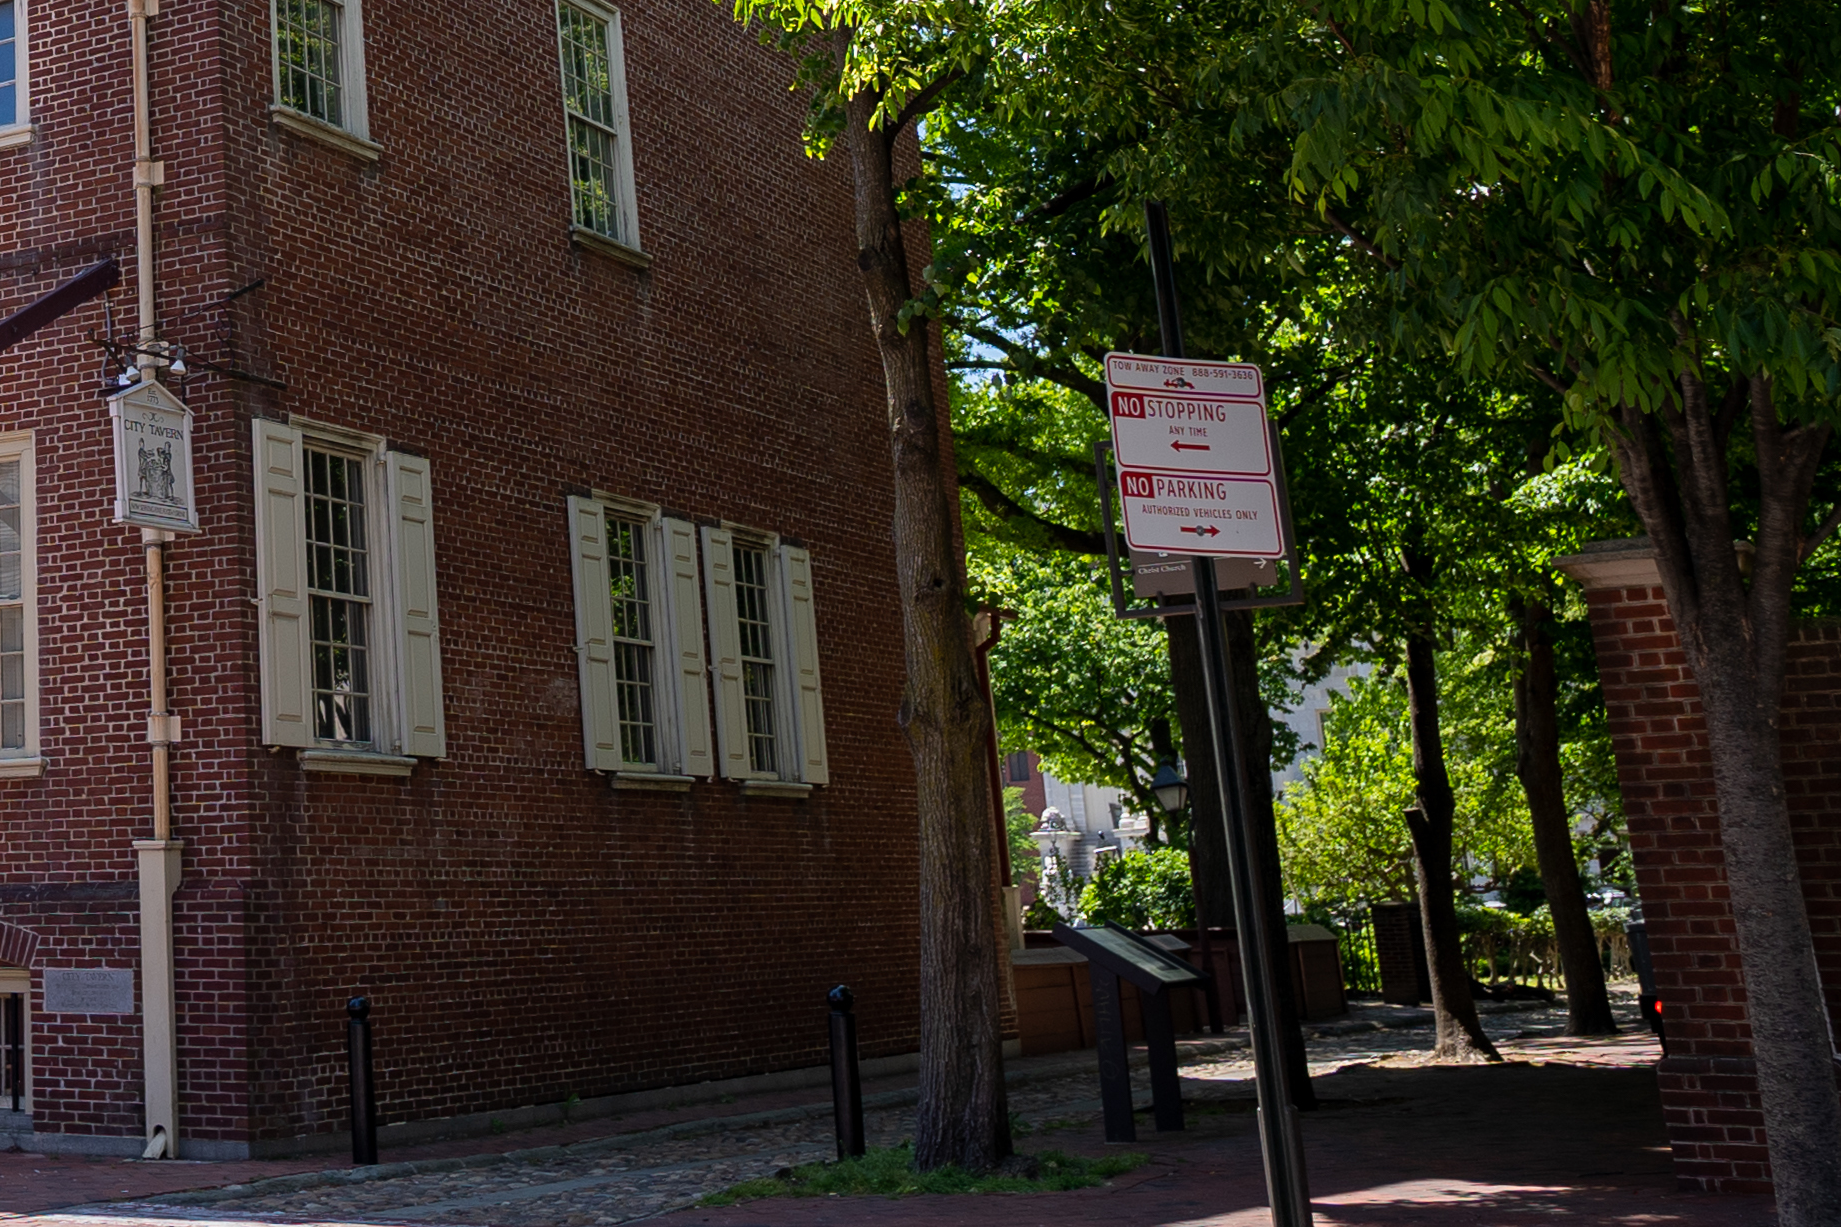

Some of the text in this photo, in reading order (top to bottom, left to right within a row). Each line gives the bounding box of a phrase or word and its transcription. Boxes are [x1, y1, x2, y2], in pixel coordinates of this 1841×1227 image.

[1113, 361, 1253, 380] TOW AWAY ZONE 888-591-3636
[1118, 396, 1226, 422] NO STOPPING
[124, 419, 183, 441] CITY TAVERN
[1169, 425, 1208, 437] ANY TIME
[1126, 476, 1227, 500] NO PARKING
[1142, 504, 1257, 520] AUTHORIZED VEHICLES ONLY
[1138, 564, 1186, 575] Christ Church
[62, 973, 114, 981] CITY TAVERN
